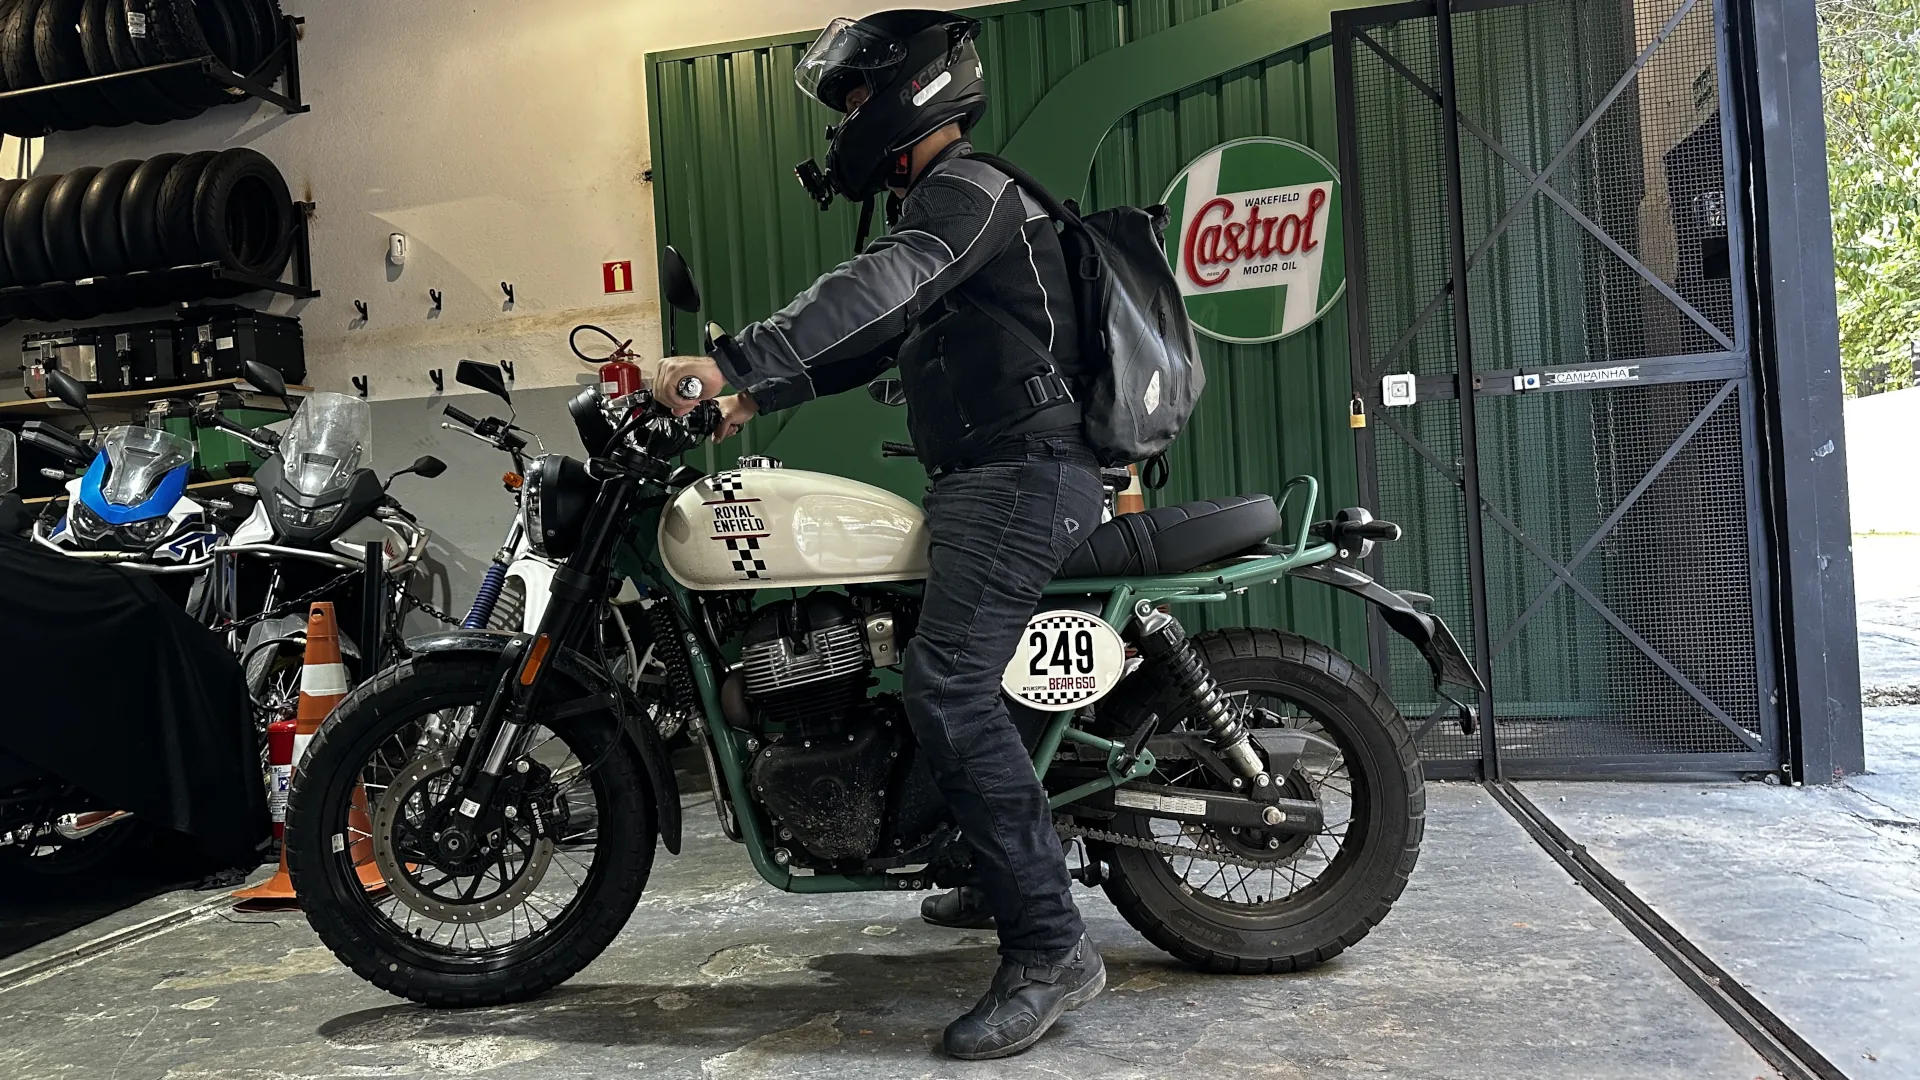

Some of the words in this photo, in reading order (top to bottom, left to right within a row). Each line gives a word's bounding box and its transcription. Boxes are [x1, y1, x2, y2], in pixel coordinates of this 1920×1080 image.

[899, 58, 946, 105] RACER
[1244, 192, 1300, 208] WAKEFIELD
[1184, 188, 1326, 287] Castrol
[1243, 263, 1278, 275] MOTOR
[1281, 261, 1297, 271] OIL
[1556, 369, 1627, 383] CAMPAINHA
[714, 505, 755, 519] ROYAL
[713, 518, 765, 533] ENFIELD
[1029, 630, 1094, 676] 249
[1048, 677, 1074, 690] BEAR
[1075, 676, 1096, 689] 650
